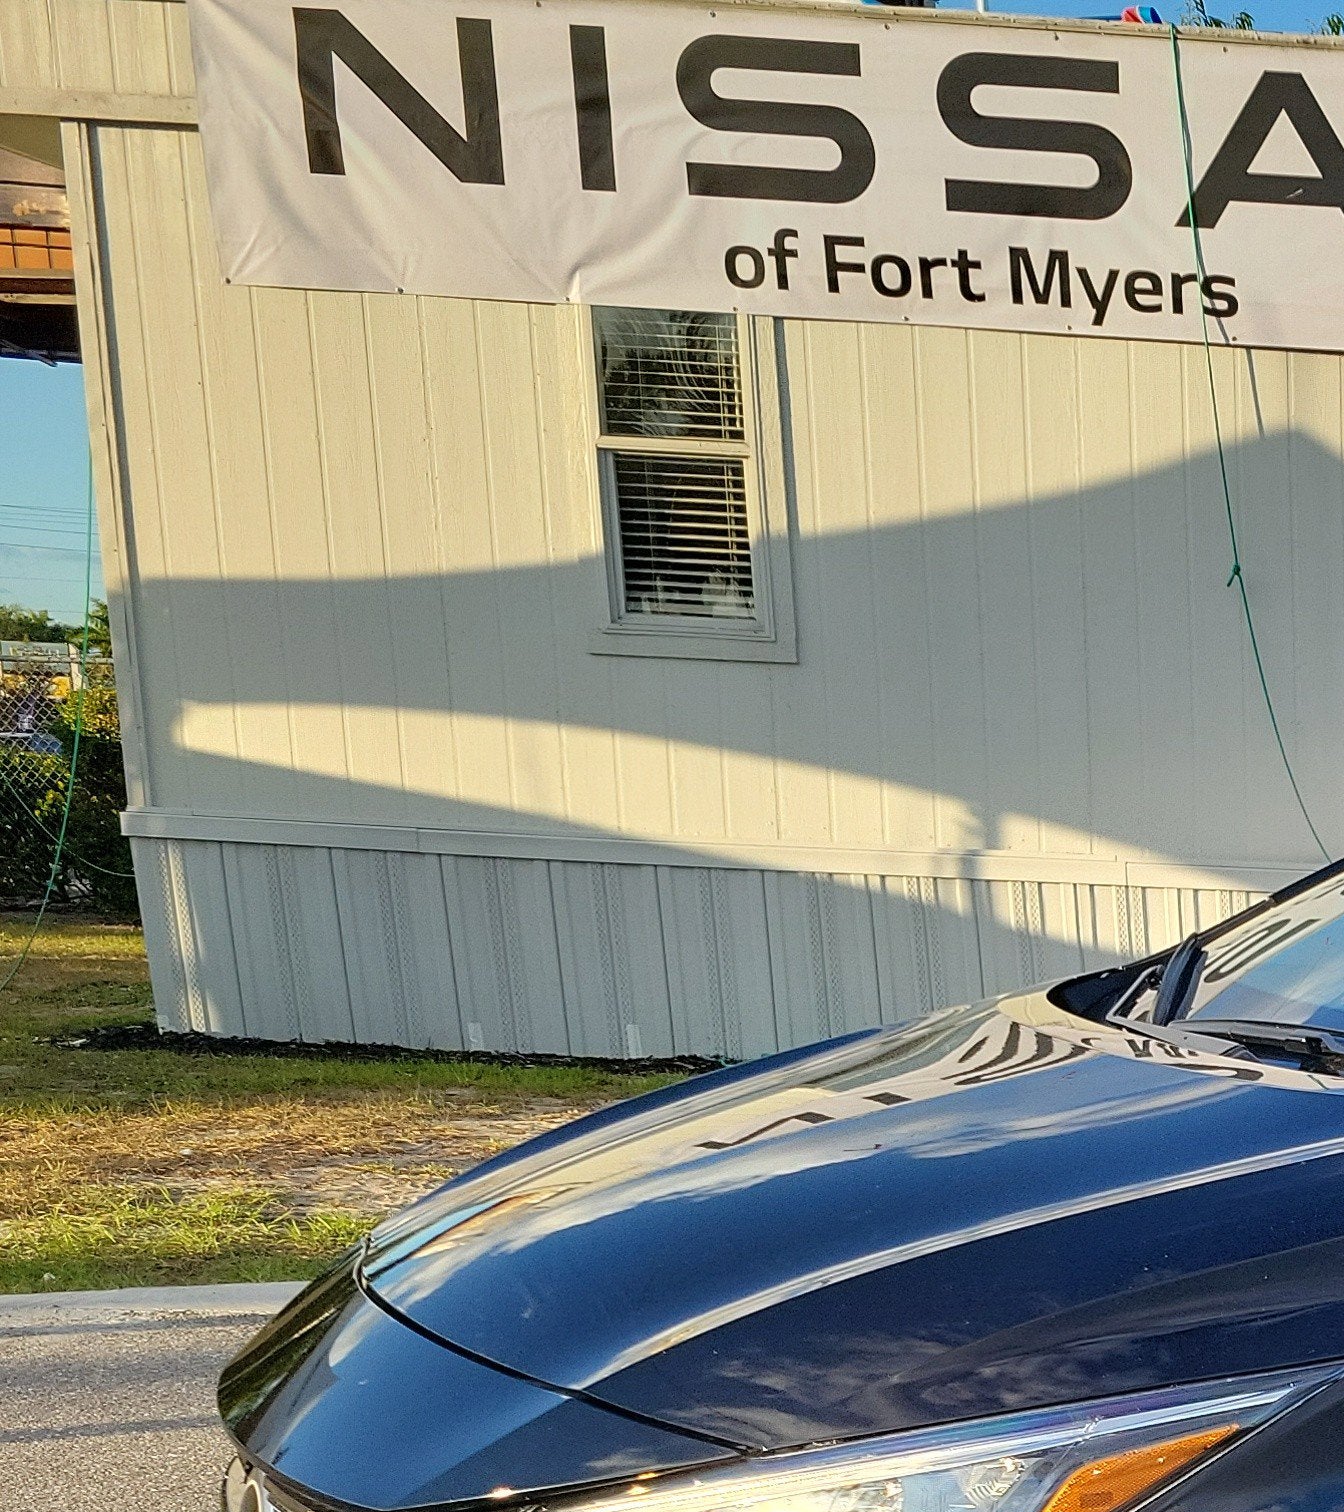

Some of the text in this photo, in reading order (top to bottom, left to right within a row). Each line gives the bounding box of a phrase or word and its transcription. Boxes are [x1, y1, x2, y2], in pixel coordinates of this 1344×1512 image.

[724, 228, 1240, 327] of Fort Myers
